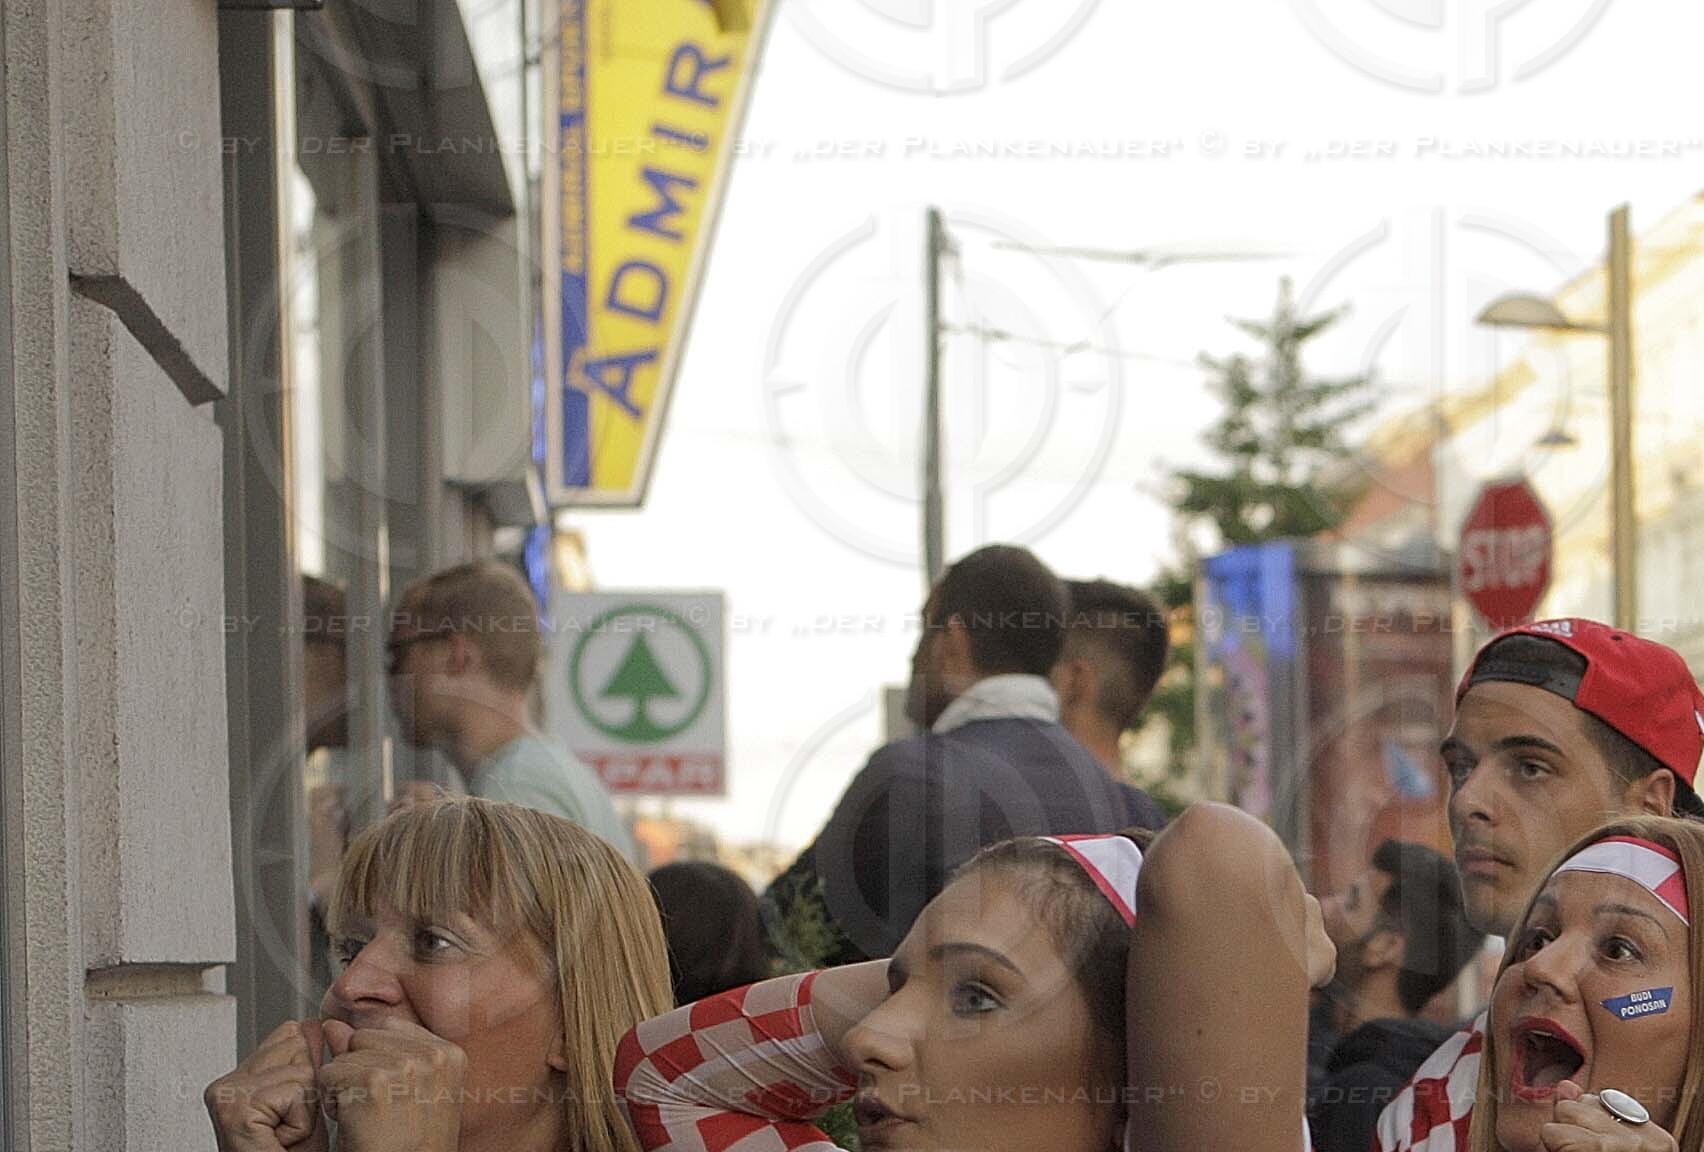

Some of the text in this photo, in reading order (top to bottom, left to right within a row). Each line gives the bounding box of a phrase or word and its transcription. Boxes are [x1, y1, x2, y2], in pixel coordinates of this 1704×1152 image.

[1460, 526, 1547, 588] STOP
[586, 756, 723, 791] PAR
[1620, 999, 1667, 1017] PONOSAN
[1631, 990, 1652, 1003] BUDI
